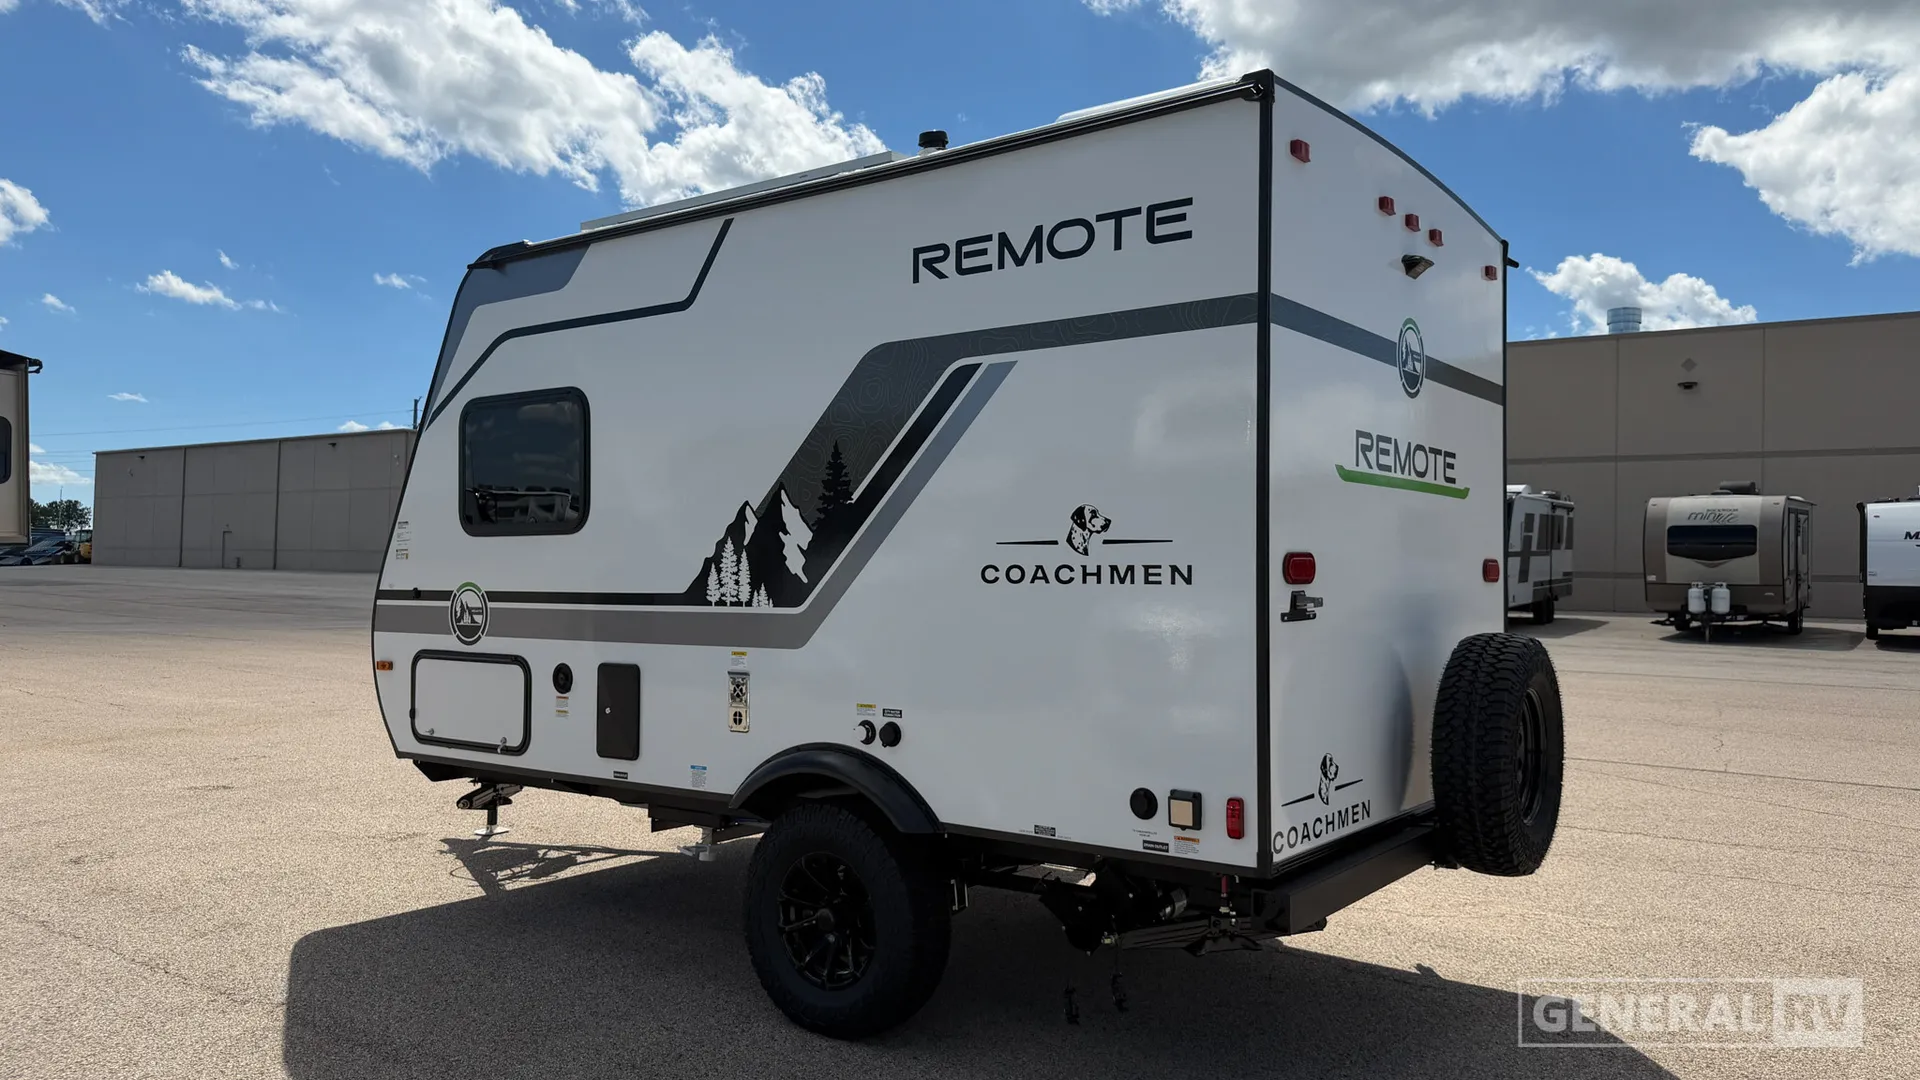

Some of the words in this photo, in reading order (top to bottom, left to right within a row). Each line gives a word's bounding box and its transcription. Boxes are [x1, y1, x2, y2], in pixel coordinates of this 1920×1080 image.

[912, 197, 1193, 284] REMOTE
[1355, 429, 1456, 484] REMOTE
[980, 564, 1193, 586] COACHMEN
[1273, 799, 1371, 854] COACHMEN
